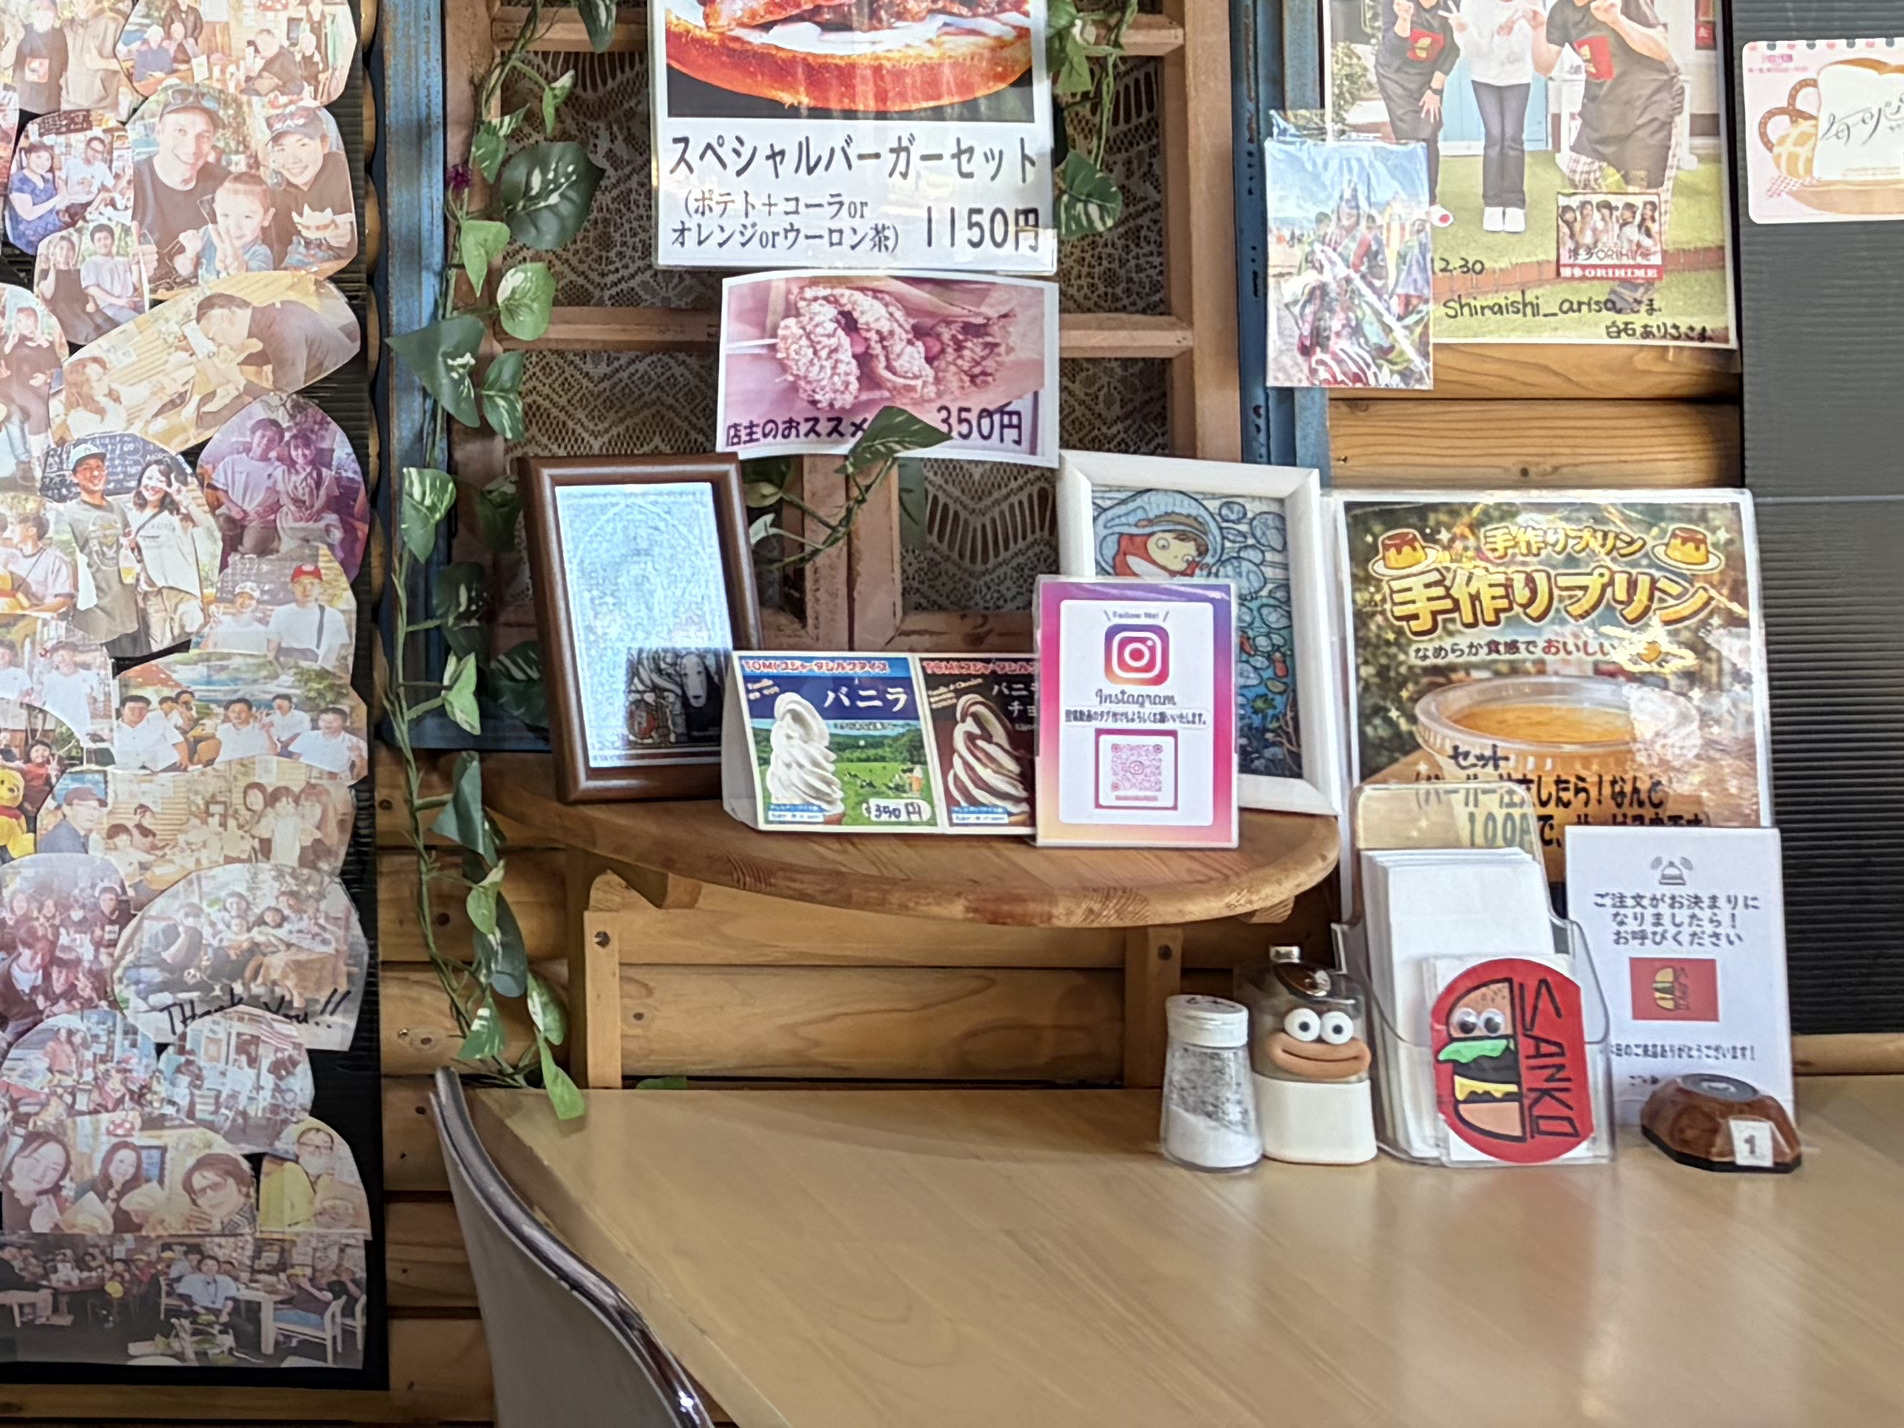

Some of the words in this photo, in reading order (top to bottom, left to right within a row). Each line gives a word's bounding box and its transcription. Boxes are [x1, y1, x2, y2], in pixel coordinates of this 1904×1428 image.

[671, 132, 1038, 183] スペシャルバーガーセット
[924, 206, 1041, 252] 1150円
[937, 403, 1024, 448] 350円
[1483, 525, 1647, 560] 手作りプリン
[1386, 566, 1722, 637] 手作りプリン
[824, 687, 909, 713] バニラ
[1095, 689, 1177, 707] Instagram
[1449, 744, 1510, 772] セット
[1594, 893, 1760, 910] ご注文がお決まりに
[1612, 911, 1738, 929] なりましたら!
[1613, 928, 1744, 948] お呼びください
[1516, 975, 1582, 1140] SANKO
[1744, 1134, 1756, 1156] 1
